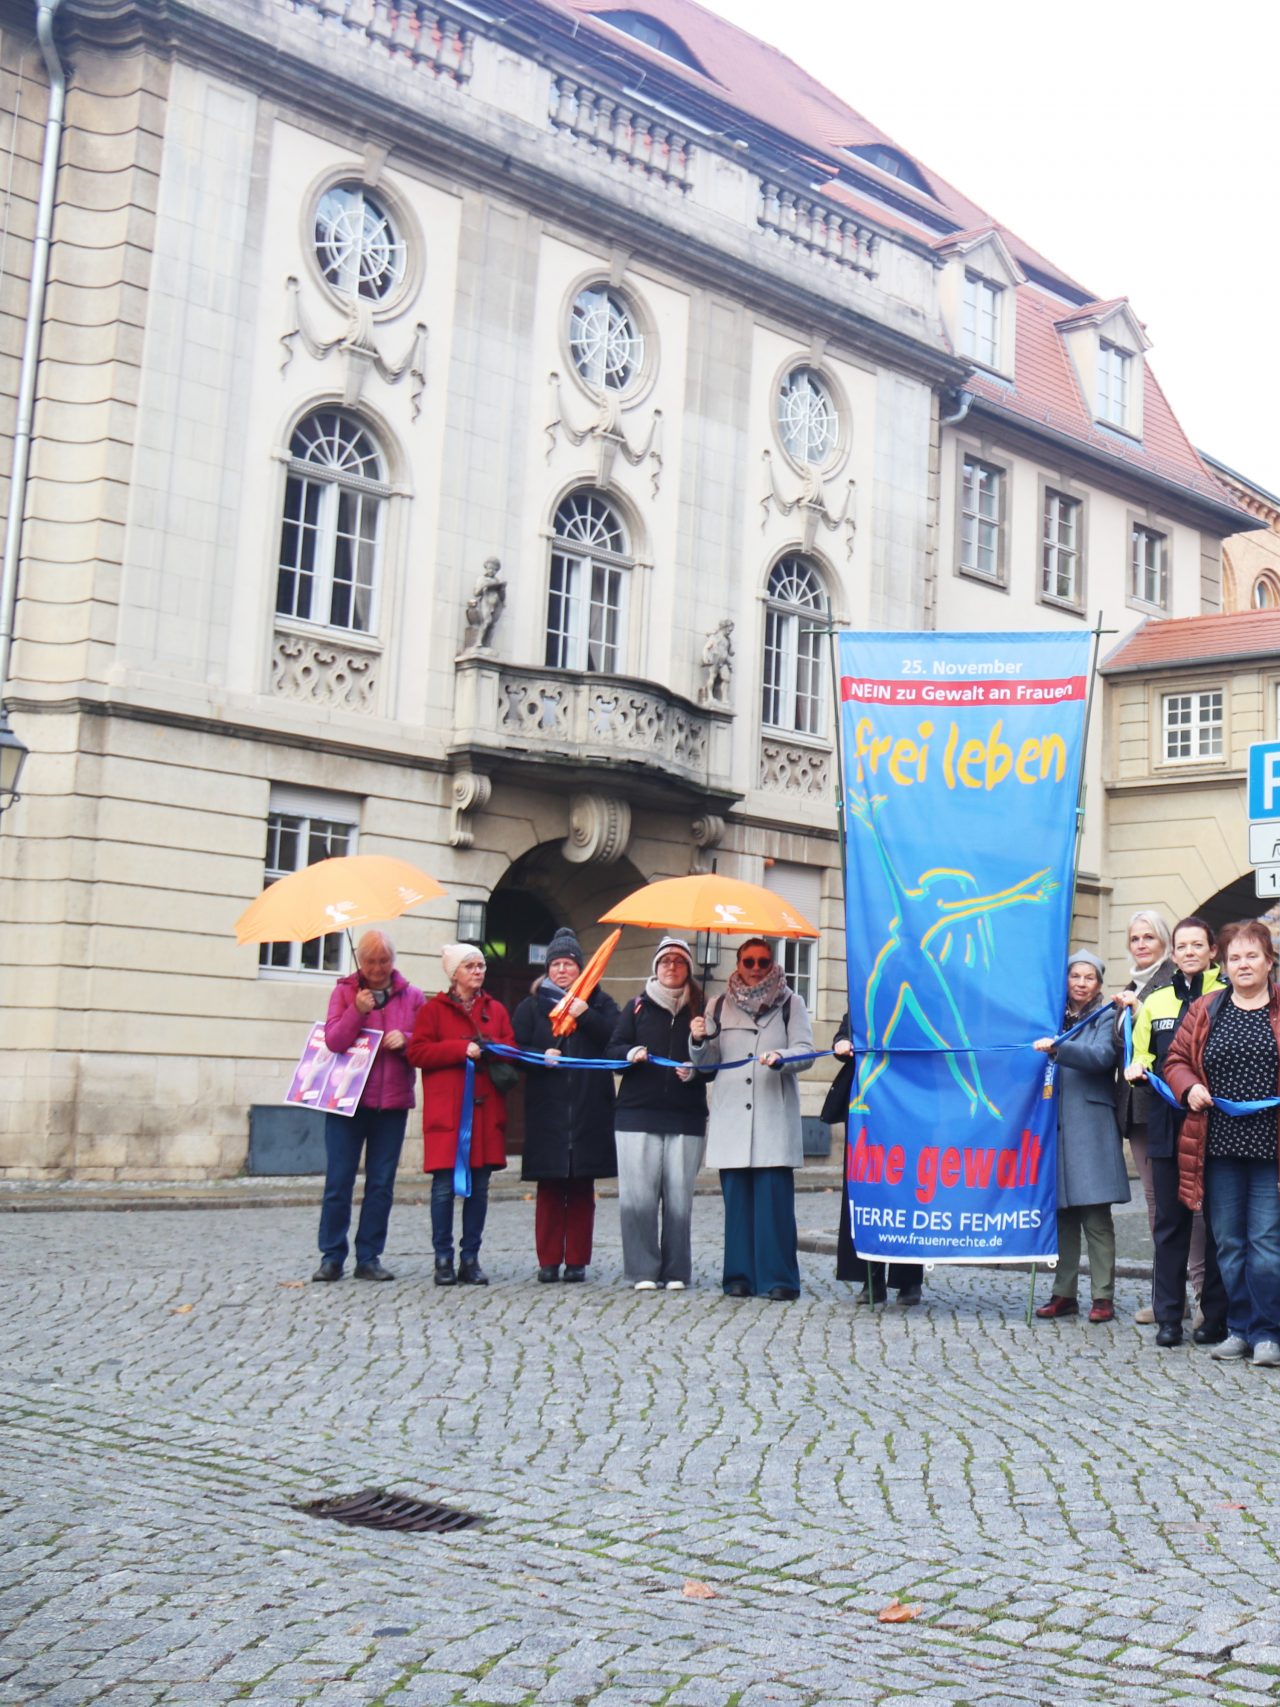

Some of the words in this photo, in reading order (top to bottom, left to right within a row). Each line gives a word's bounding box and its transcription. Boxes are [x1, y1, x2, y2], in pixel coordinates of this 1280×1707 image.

[901, 659, 927, 675] 25.
[932, 659, 1023, 676] November
[850, 682, 892, 700] NEIN
[896, 687, 916, 701] zu
[921, 685, 985, 701] Gewalt
[989, 687, 1011, 700] an
[1016, 683, 1073, 700] Frauen
[854, 717, 935, 786] frei
[943, 719, 1067, 791] leben
[915, 1128, 1042, 1205] gewalt
[854, 1206, 907, 1229] TERRE
[912, 1209, 952, 1231] DES
[959, 1208, 1042, 1232] FEMMES
[878, 1231, 1003, 1249] www.frauenrechte.de
